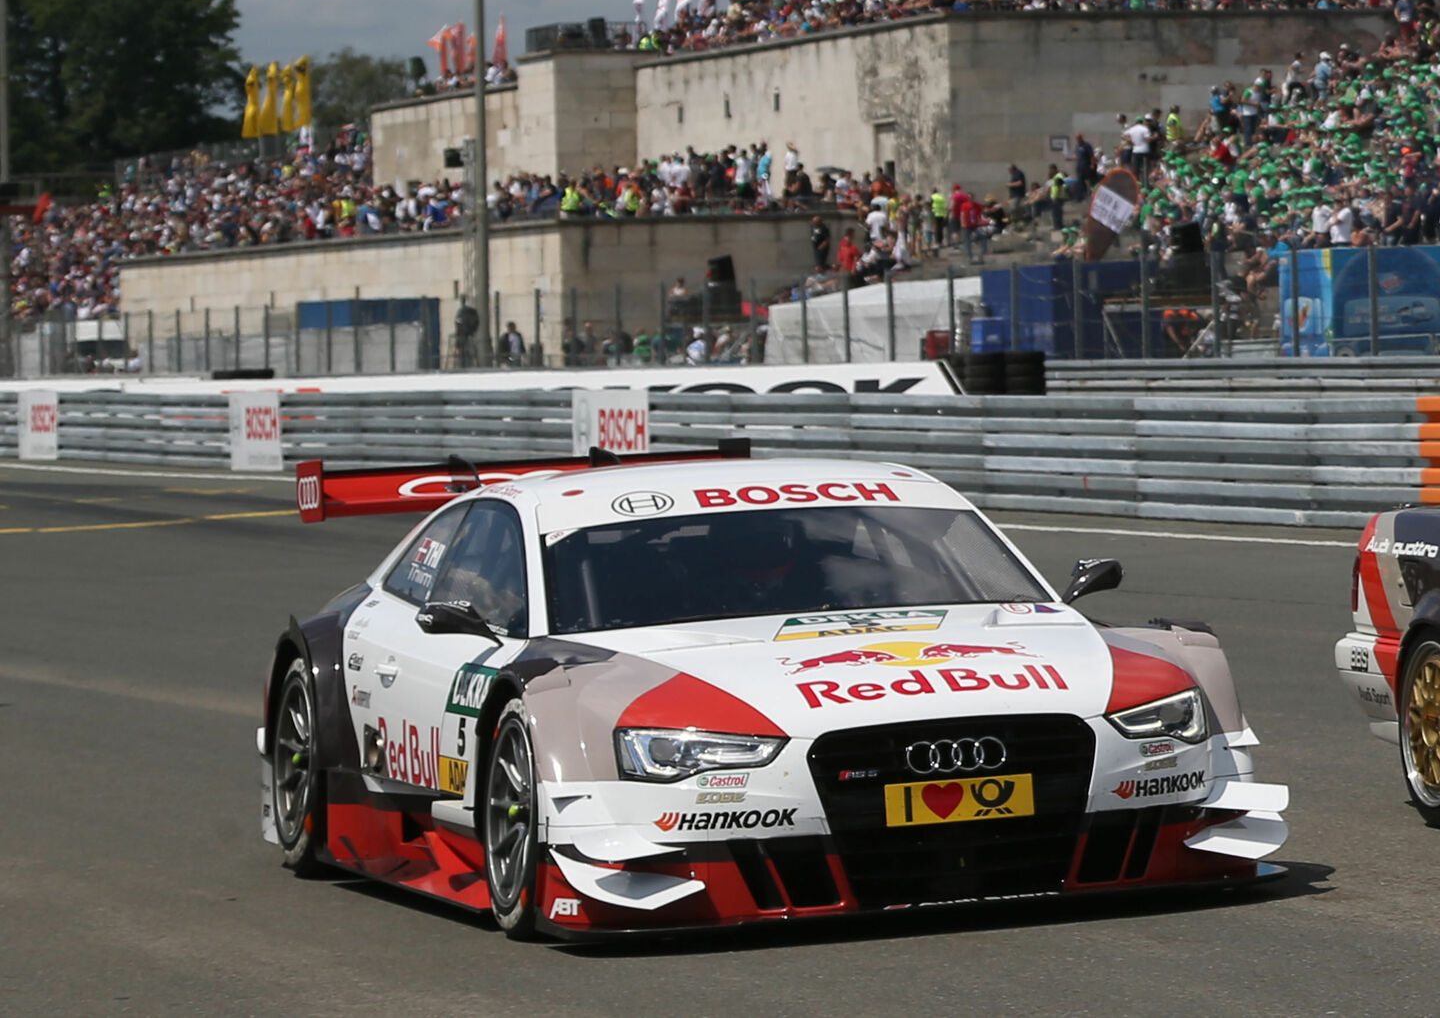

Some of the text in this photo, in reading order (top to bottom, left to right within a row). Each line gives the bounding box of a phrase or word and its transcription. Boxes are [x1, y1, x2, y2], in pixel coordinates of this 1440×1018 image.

[31, 404, 57, 432] BOSCH
[245, 407, 279, 440] BOSCH
[598, 409, 646, 451] BOSCH
[694, 483, 900, 508] BOSCH
[1392, 541, 1439, 558] quattro
[796, 610, 936, 624] DEKRA
[818, 626, 908, 637] ADAC
[796, 664, 1069, 709] Red Bull
[457, 718, 467, 757] 5
[378, 717, 440, 791] Red Bull
[449, 761, 467, 793] ADA
[709, 775, 746, 787] Castrol
[904, 786, 913, 823] I
[549, 898, 582, 920] ABT
